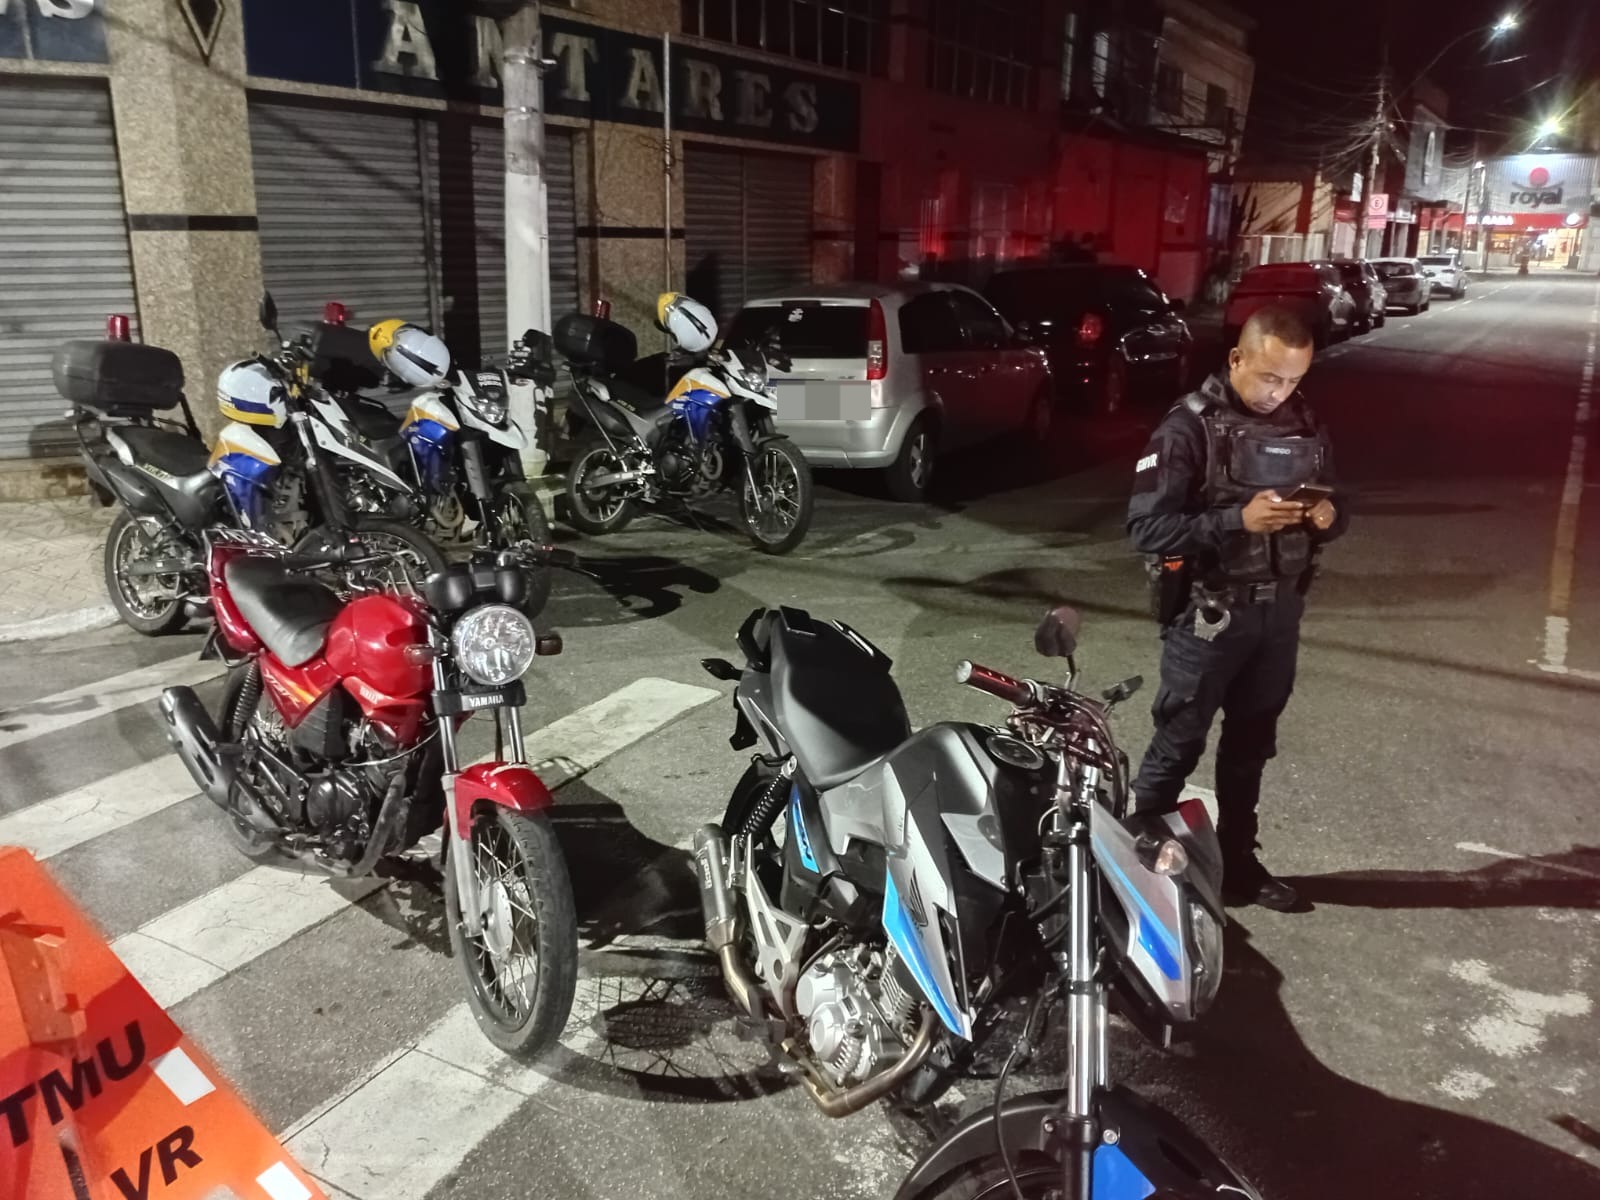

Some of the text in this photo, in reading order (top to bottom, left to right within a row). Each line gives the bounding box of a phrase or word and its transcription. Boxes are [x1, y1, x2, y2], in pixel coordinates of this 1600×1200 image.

[371, 0, 819, 134] ANTARES
[1510, 187, 1563, 209] royal
[469, 694, 504, 707] YAMAHA
[0, 1020, 146, 1148] TMU
[110, 1125, 203, 1200] VR
